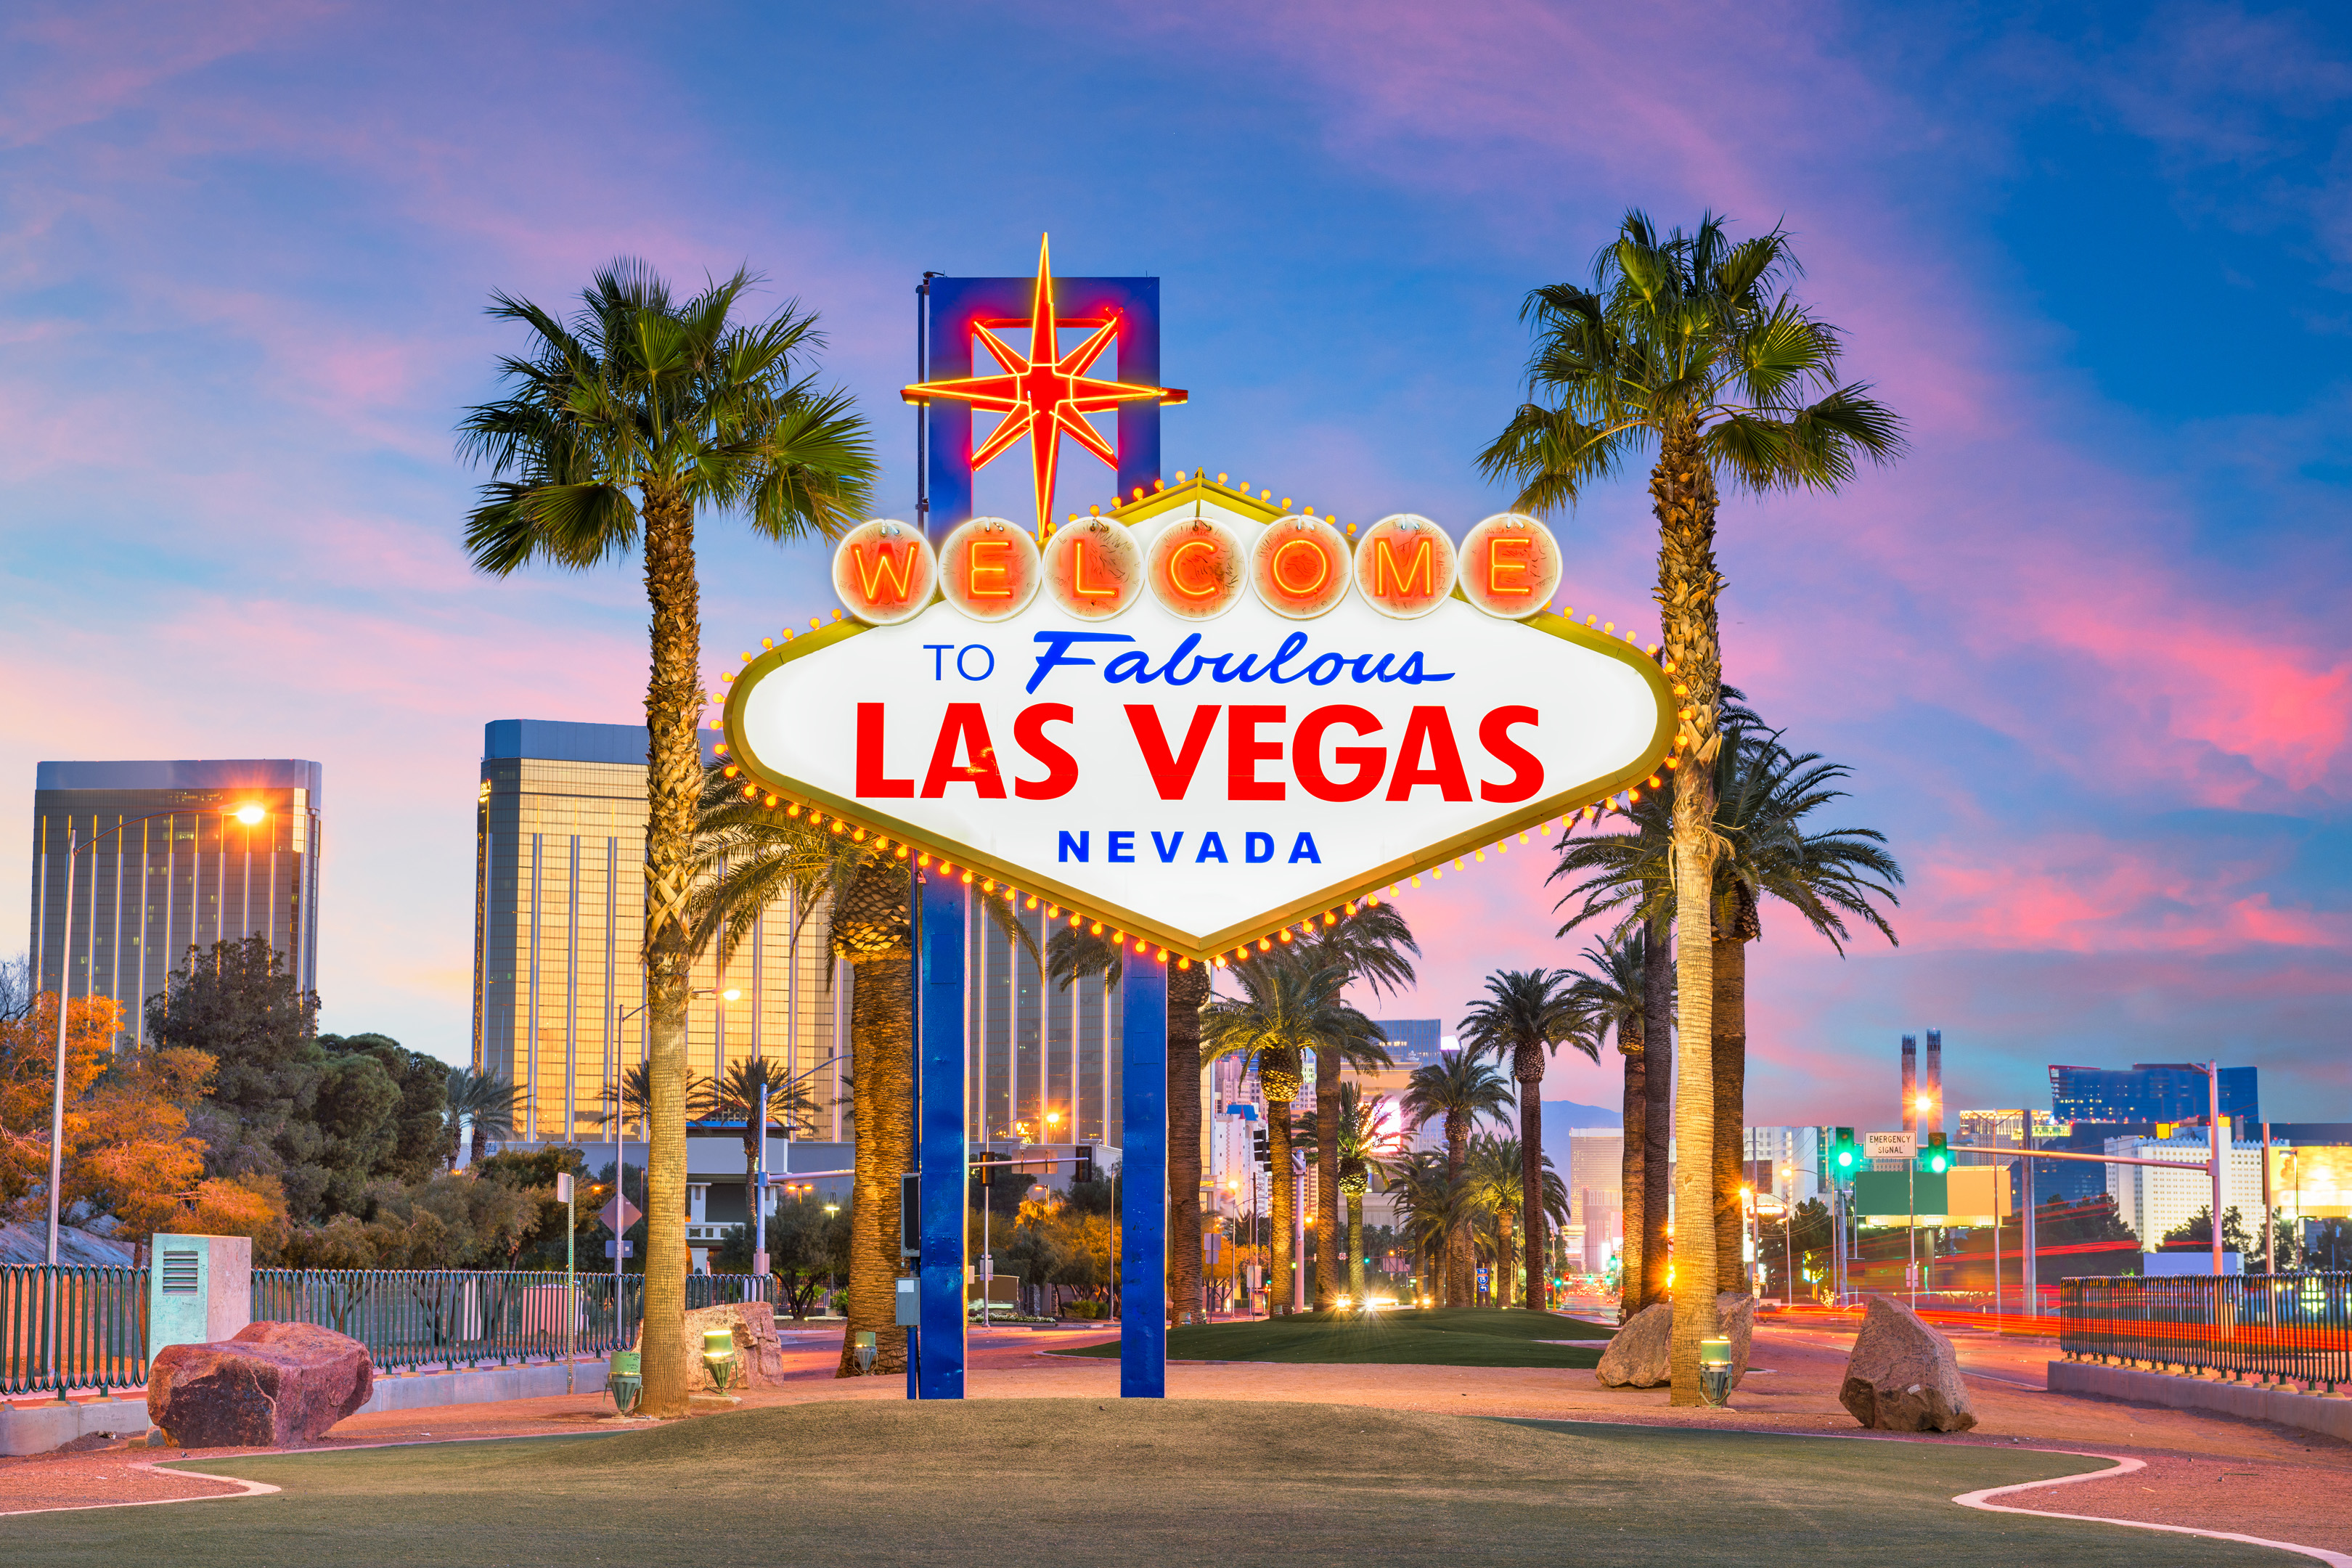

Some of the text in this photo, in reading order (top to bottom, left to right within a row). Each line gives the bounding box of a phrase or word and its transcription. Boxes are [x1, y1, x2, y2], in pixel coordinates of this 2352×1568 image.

[850, 536, 1532, 605] WELCOME
[923, 631, 1455, 695] TO Fabulous
[855, 702, 1545, 804] LAS VEGAS
[1058, 830, 1322, 864] NEVADA
